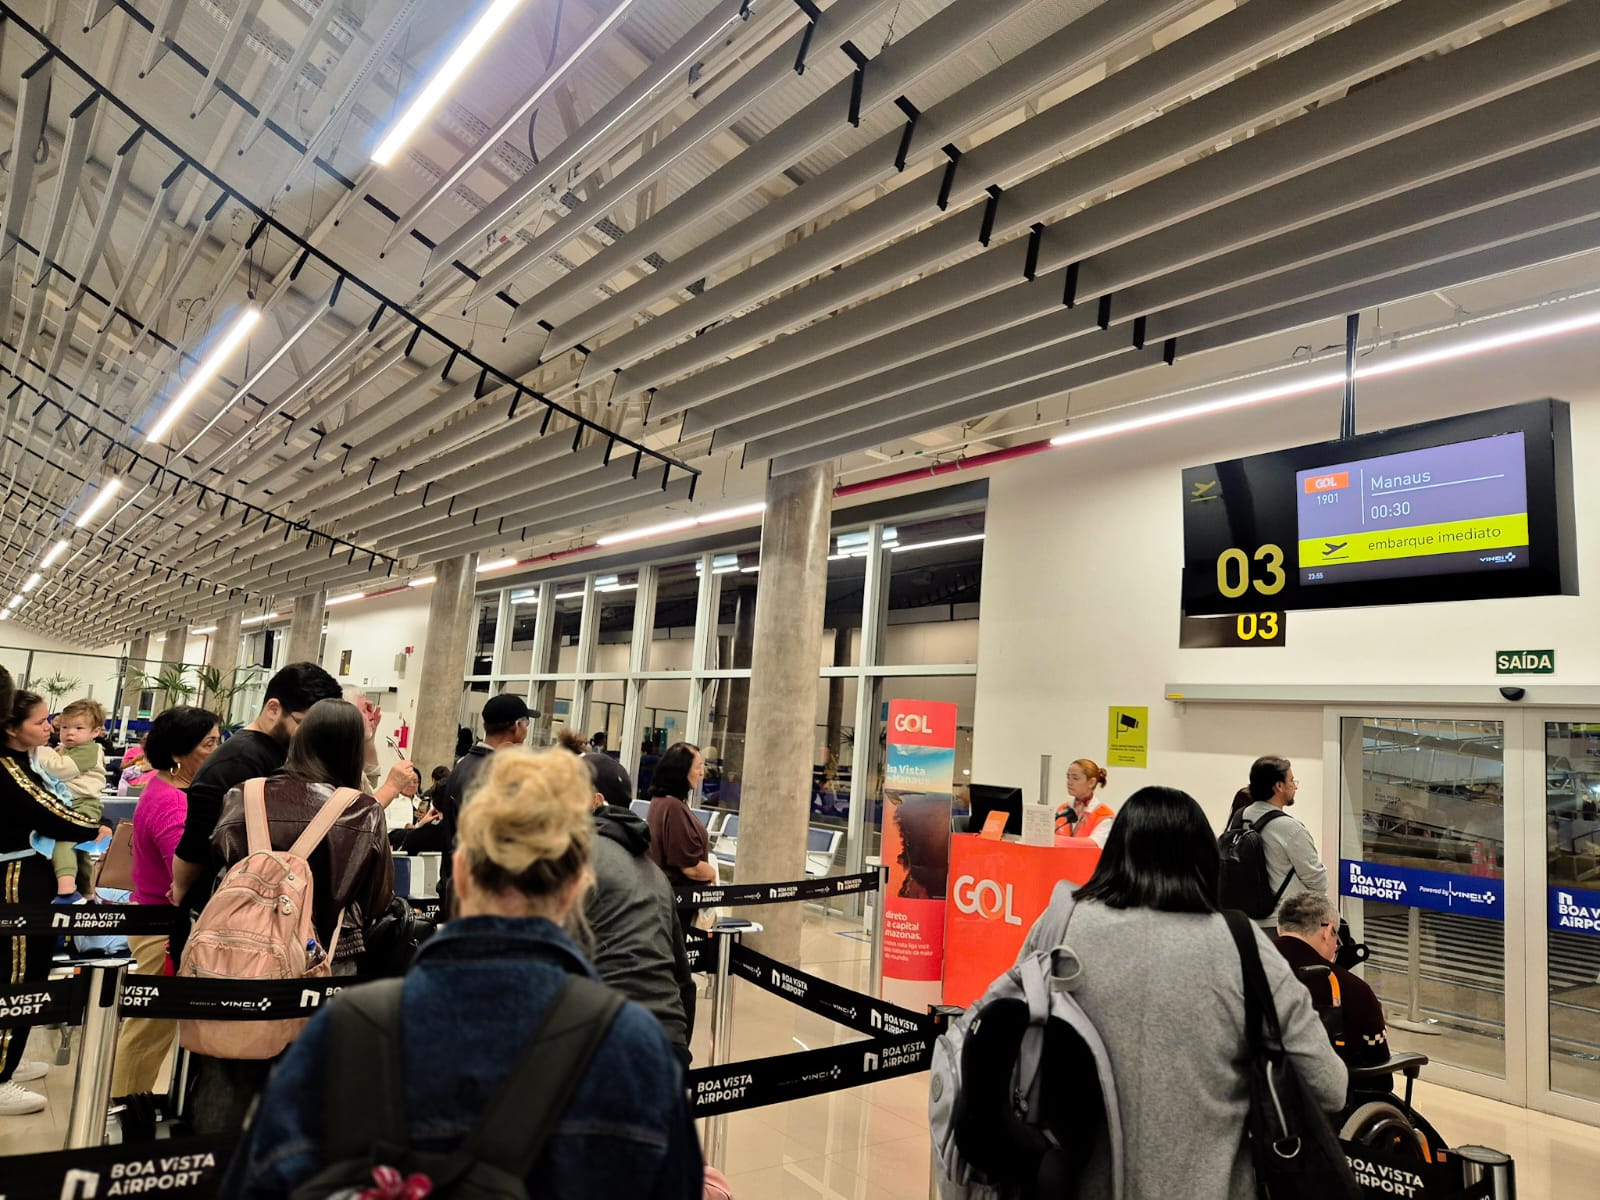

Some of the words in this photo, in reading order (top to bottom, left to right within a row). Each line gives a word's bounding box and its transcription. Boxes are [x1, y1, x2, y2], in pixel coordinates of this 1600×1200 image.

[1315, 477, 1337, 489] GOL
[1371, 472, 1431, 490] Manaus
[1317, 493, 1339, 505] 1901
[1371, 501, 1410, 519] 00:30
[1368, 534, 1434, 551] embarque
[1438, 527, 1501, 543] imediato
[1217, 544, 1286, 598] 03
[1237, 612, 1279, 640] 03
[1498, 652, 1552, 669] SAÍDA
[894, 713, 933, 734] GOL
[899, 764, 927, 776] Vista
[1350, 874, 1374, 886] BOA
[1419, 885, 1442, 895] Powered
[1442, 888, 1450, 897] by
[1451, 891, 1482, 900] VINCI
[953, 874, 1023, 926] GOL
[75, 912, 97, 921] BOA
[886, 910, 908, 921] direto
[1559, 904, 1590, 918] BOA
[892, 922, 920, 931] capital
[686, 950, 700, 958] STA
[782, 973, 793, 985] BOA
[325, 987, 342, 996] BO
[0, 1004, 43, 1018] PORT
[221, 1000, 255, 1008] VINCI
[884, 1013, 899, 1026] BOA
[882, 1046, 901, 1058] BOA
[697, 1079, 721, 1093] BOA
[802, 1072, 829, 1081] VINCI
[110, 1160, 155, 1179] BOA
[1355, 1171, 1416, 1199] iRPORT
